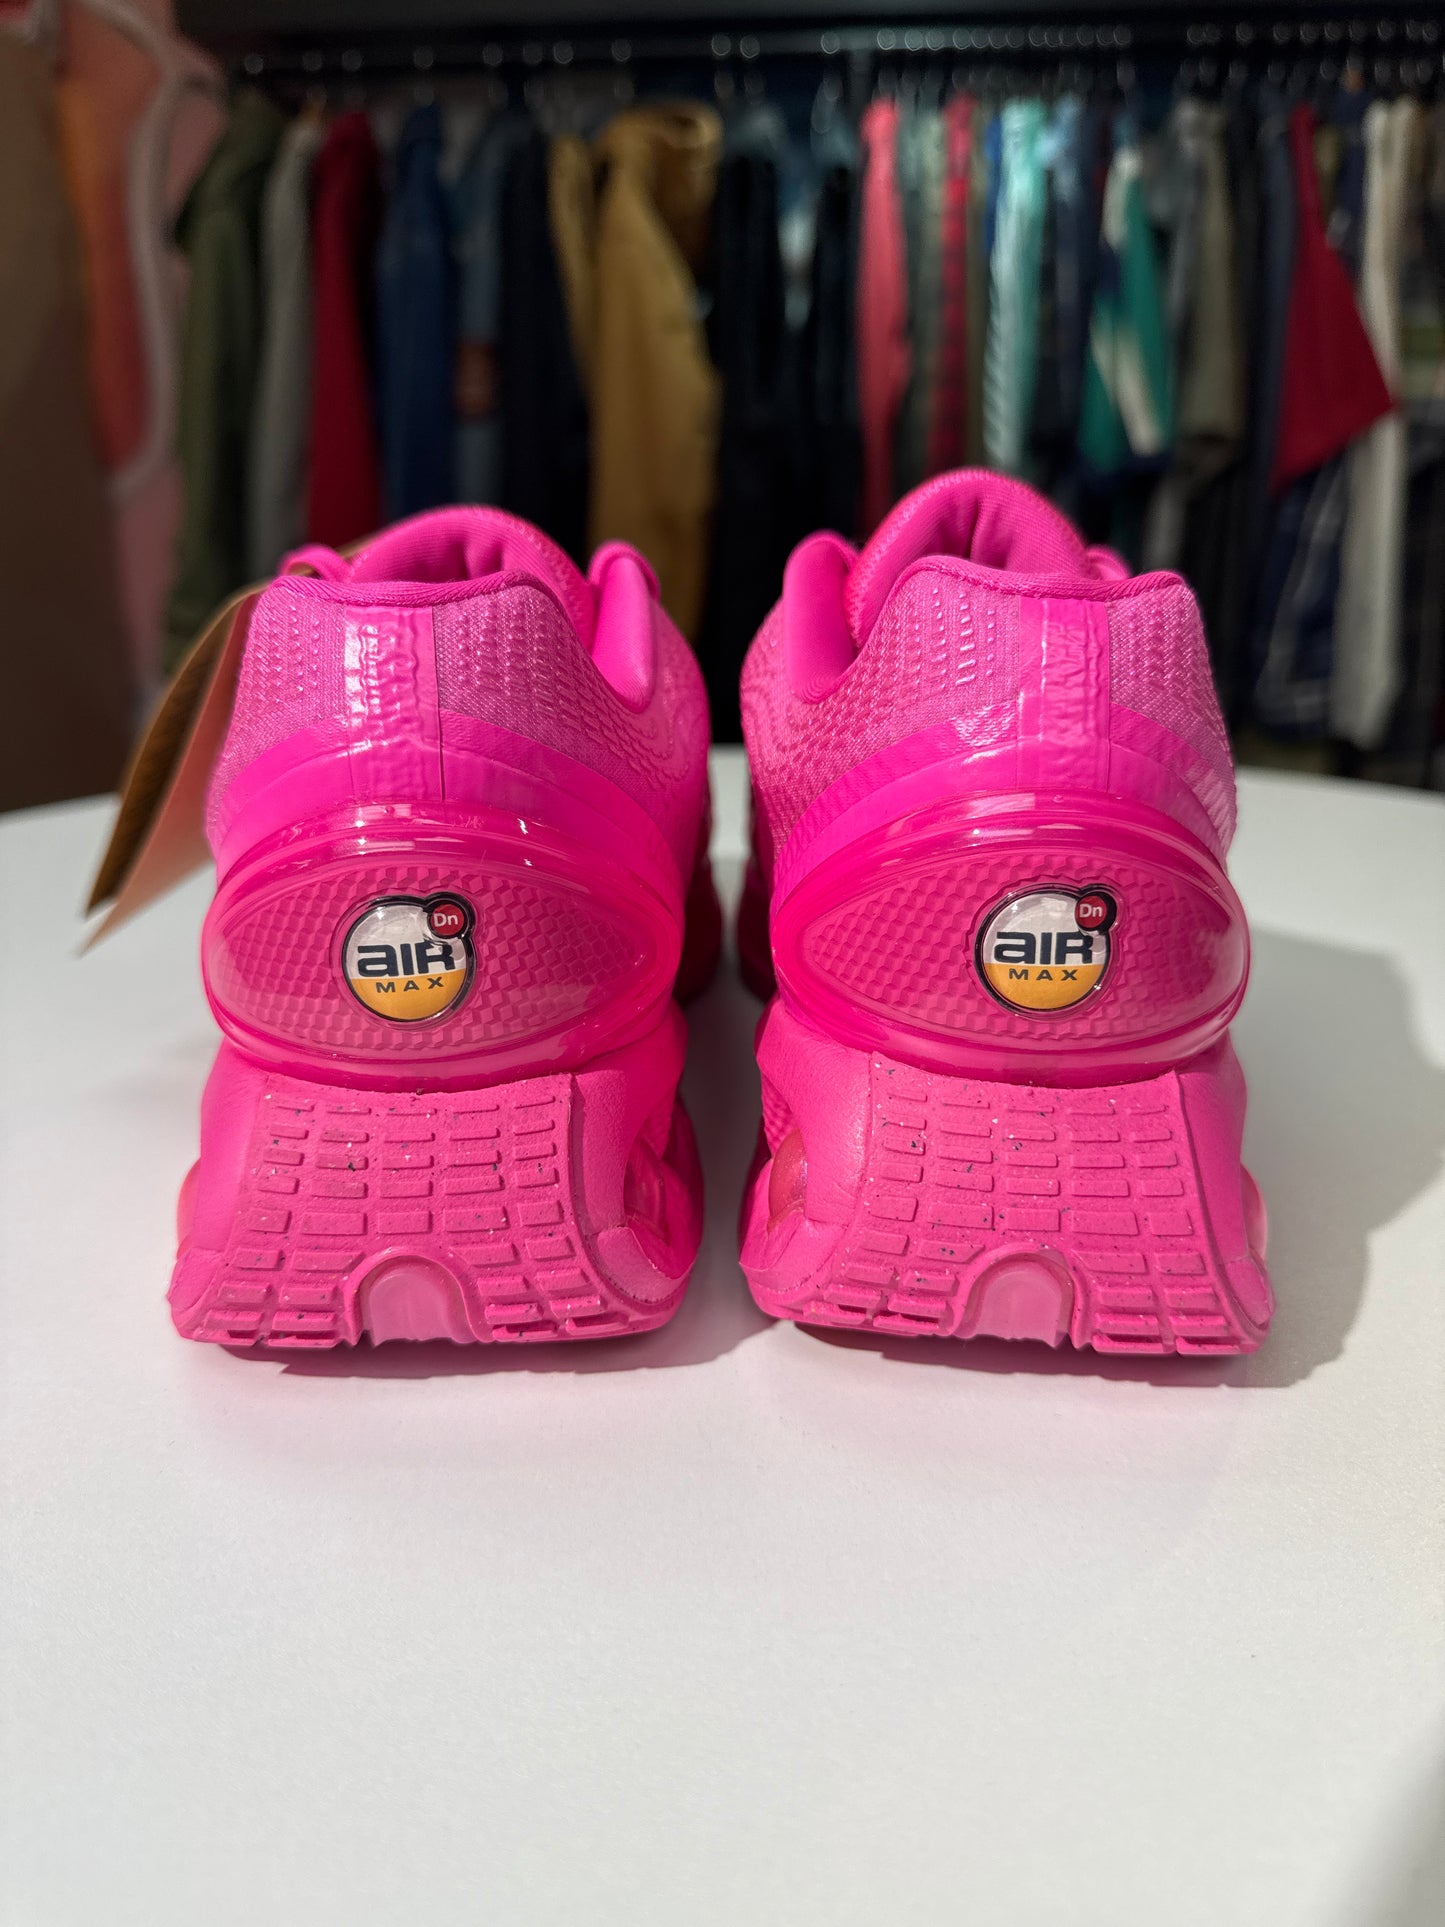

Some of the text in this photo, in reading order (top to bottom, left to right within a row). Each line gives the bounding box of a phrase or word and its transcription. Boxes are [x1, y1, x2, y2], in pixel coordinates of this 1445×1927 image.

[1079, 903, 1103, 918] Dn
[433, 912, 459, 927] Dn
[1008, 968, 1079, 981] MAX
[375, 976, 444, 993] MAX
